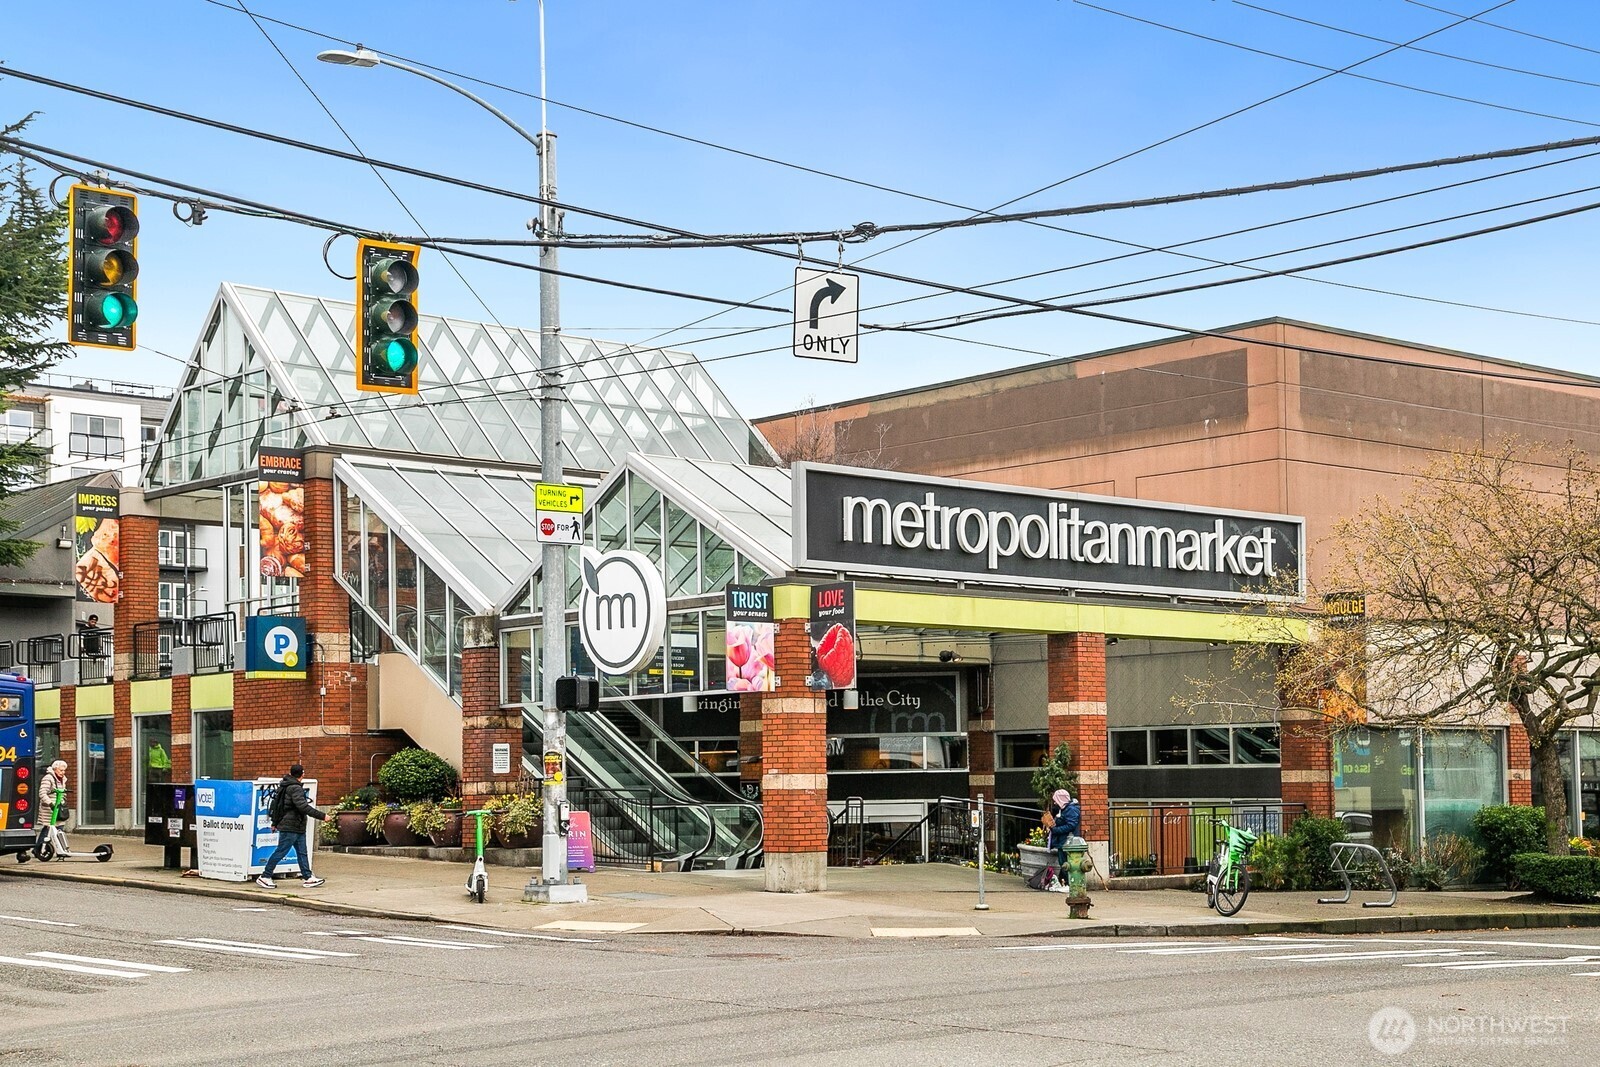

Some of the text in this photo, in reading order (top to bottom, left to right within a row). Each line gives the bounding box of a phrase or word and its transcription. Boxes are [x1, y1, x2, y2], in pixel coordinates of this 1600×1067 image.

[803, 334, 850, 354] ONLY
[260, 455, 302, 469] EMBRACE
[277, 469, 299, 477] craving
[78, 493, 117, 507] IMPRESS
[539, 489, 567, 497] TURNING
[538, 500, 568, 508] VEHICLES
[541, 522, 555, 531] STOP
[843, 492, 1277, 578] metropolitanmarket
[731, 591, 769, 609] TRUST
[818, 589, 845, 608] LOVE
[818, 607, 845, 617] your food
[273, 634, 290, 654] P
[698, 698, 740, 713] ringin
[860, 690, 920, 709] the City
[198, 791, 213, 803] vote!
[202, 819, 244, 832] Ballot drop box
[568, 830, 586, 838] RIN
